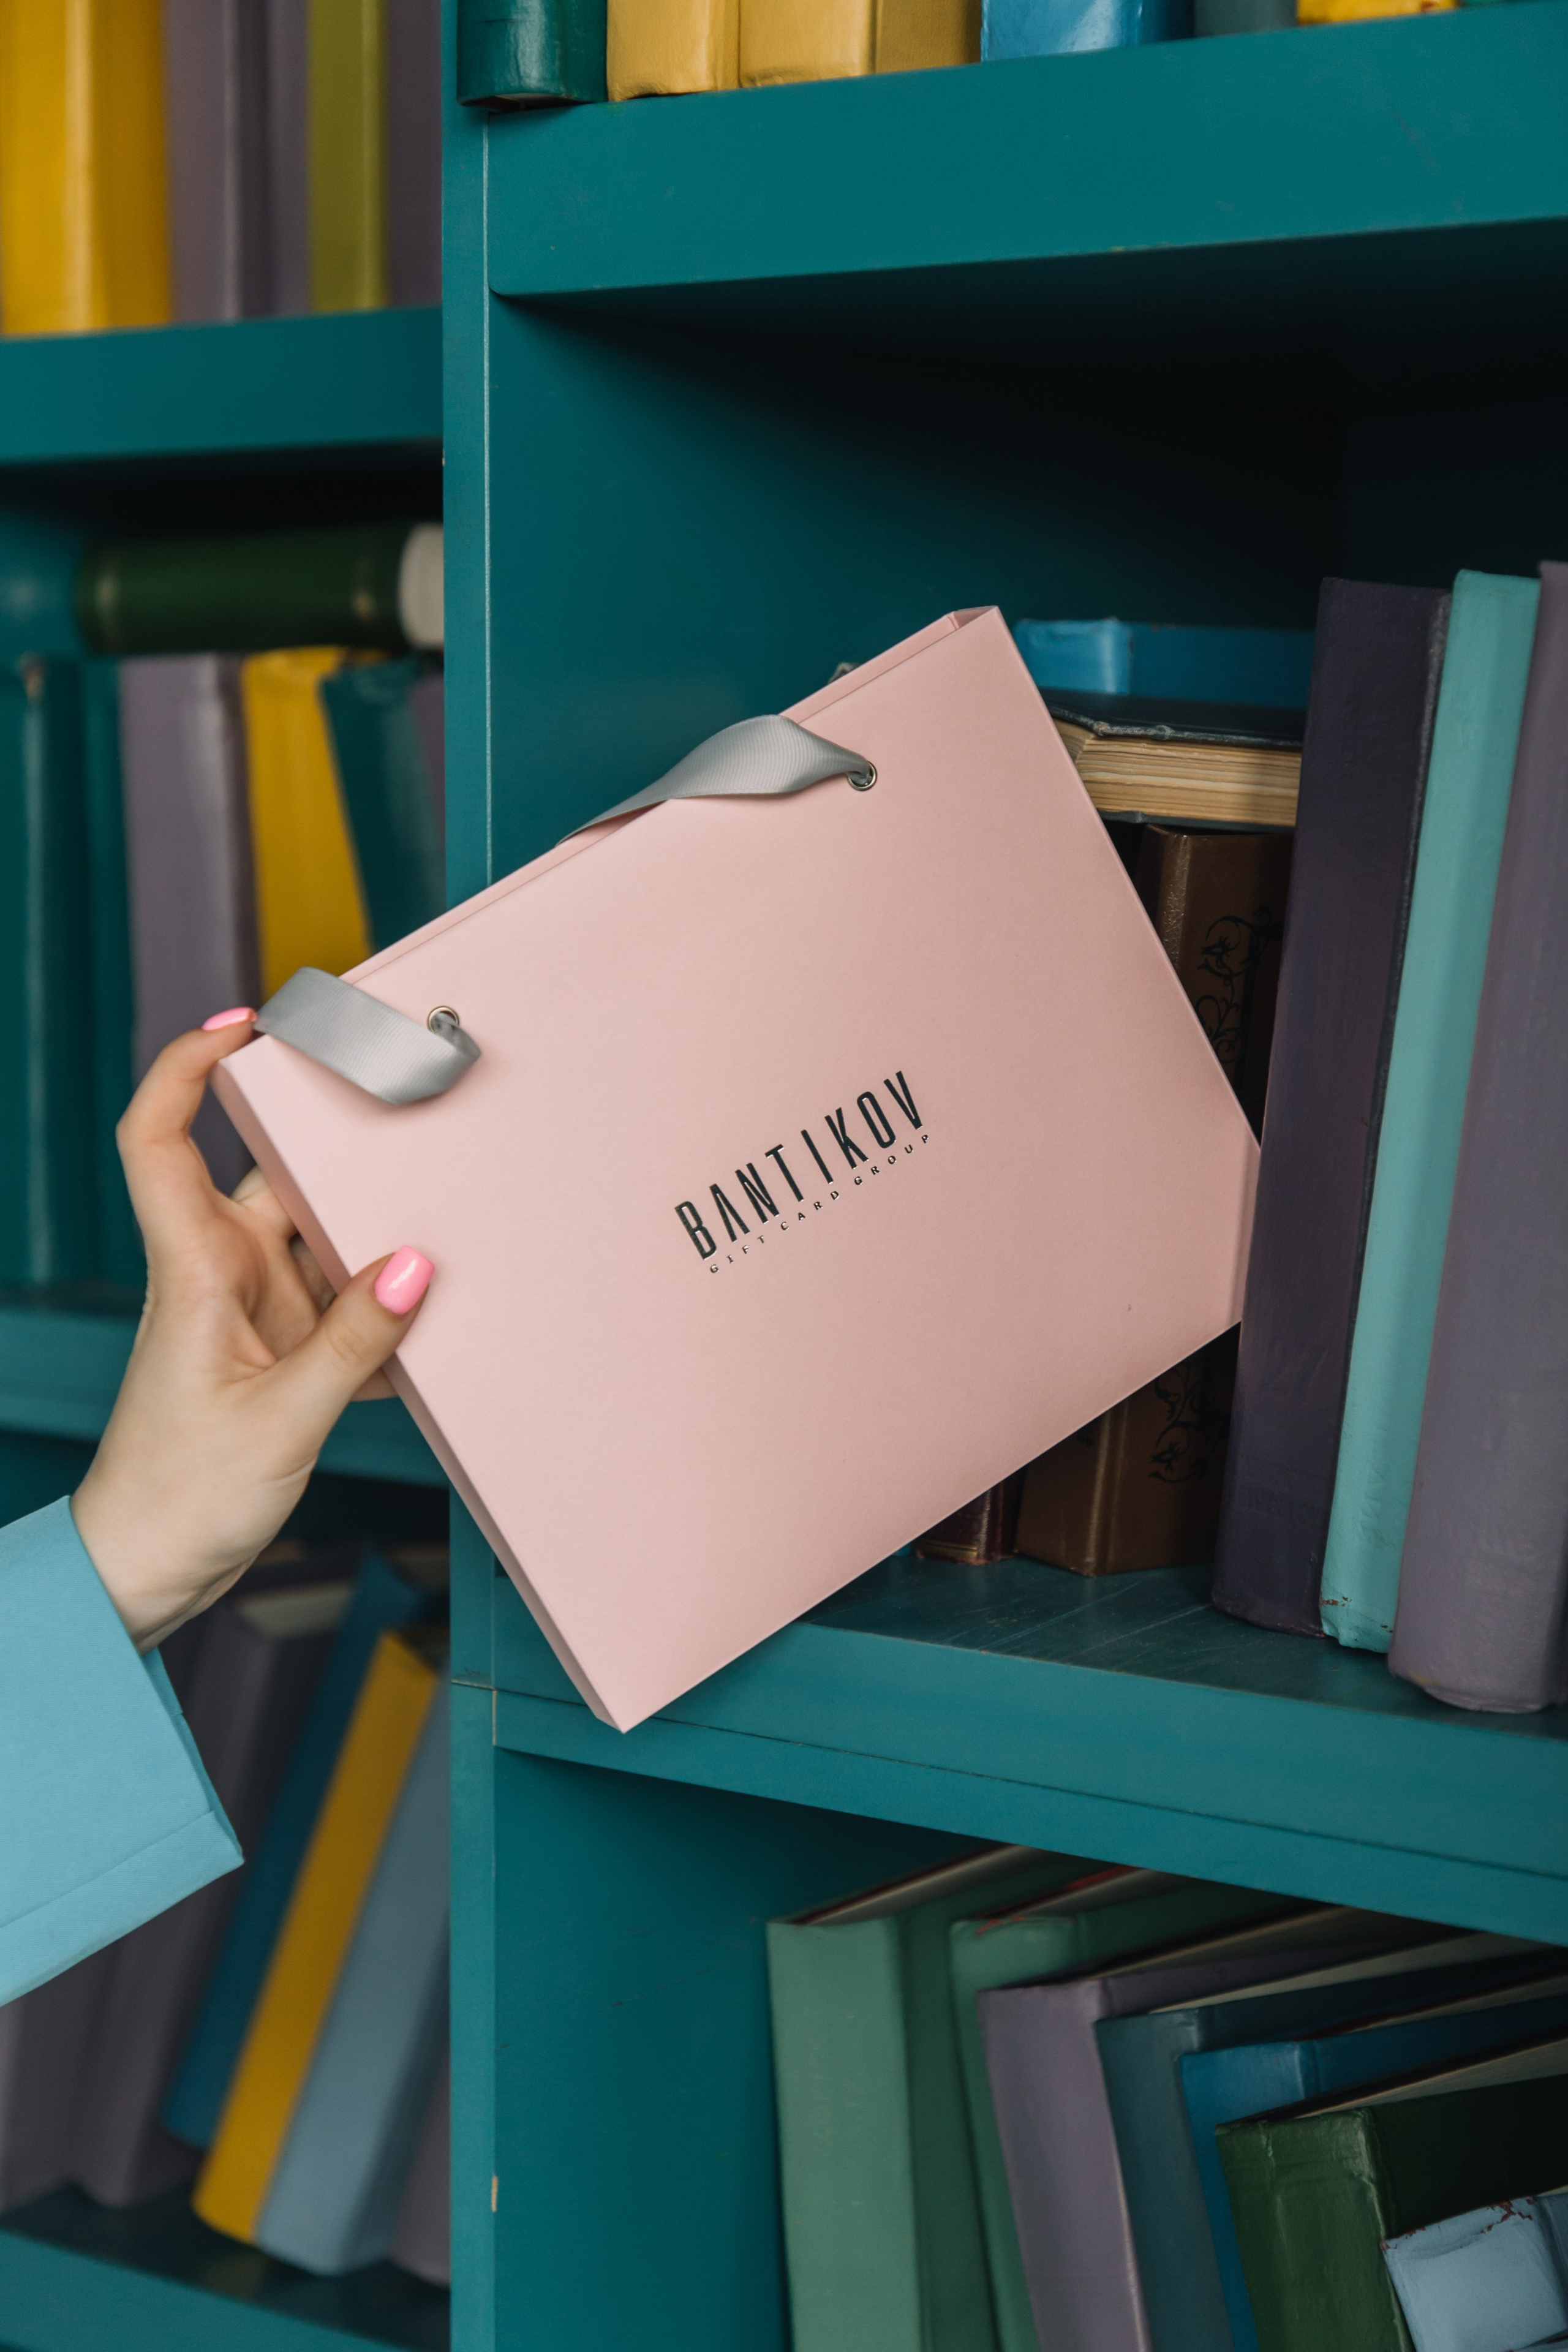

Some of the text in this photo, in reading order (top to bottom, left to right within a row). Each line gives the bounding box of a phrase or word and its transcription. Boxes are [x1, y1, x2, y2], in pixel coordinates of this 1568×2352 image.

[674, 1070, 923, 1261] BANTIKOV
[709, 1134, 929, 1274] GIFT CARD GROUP
